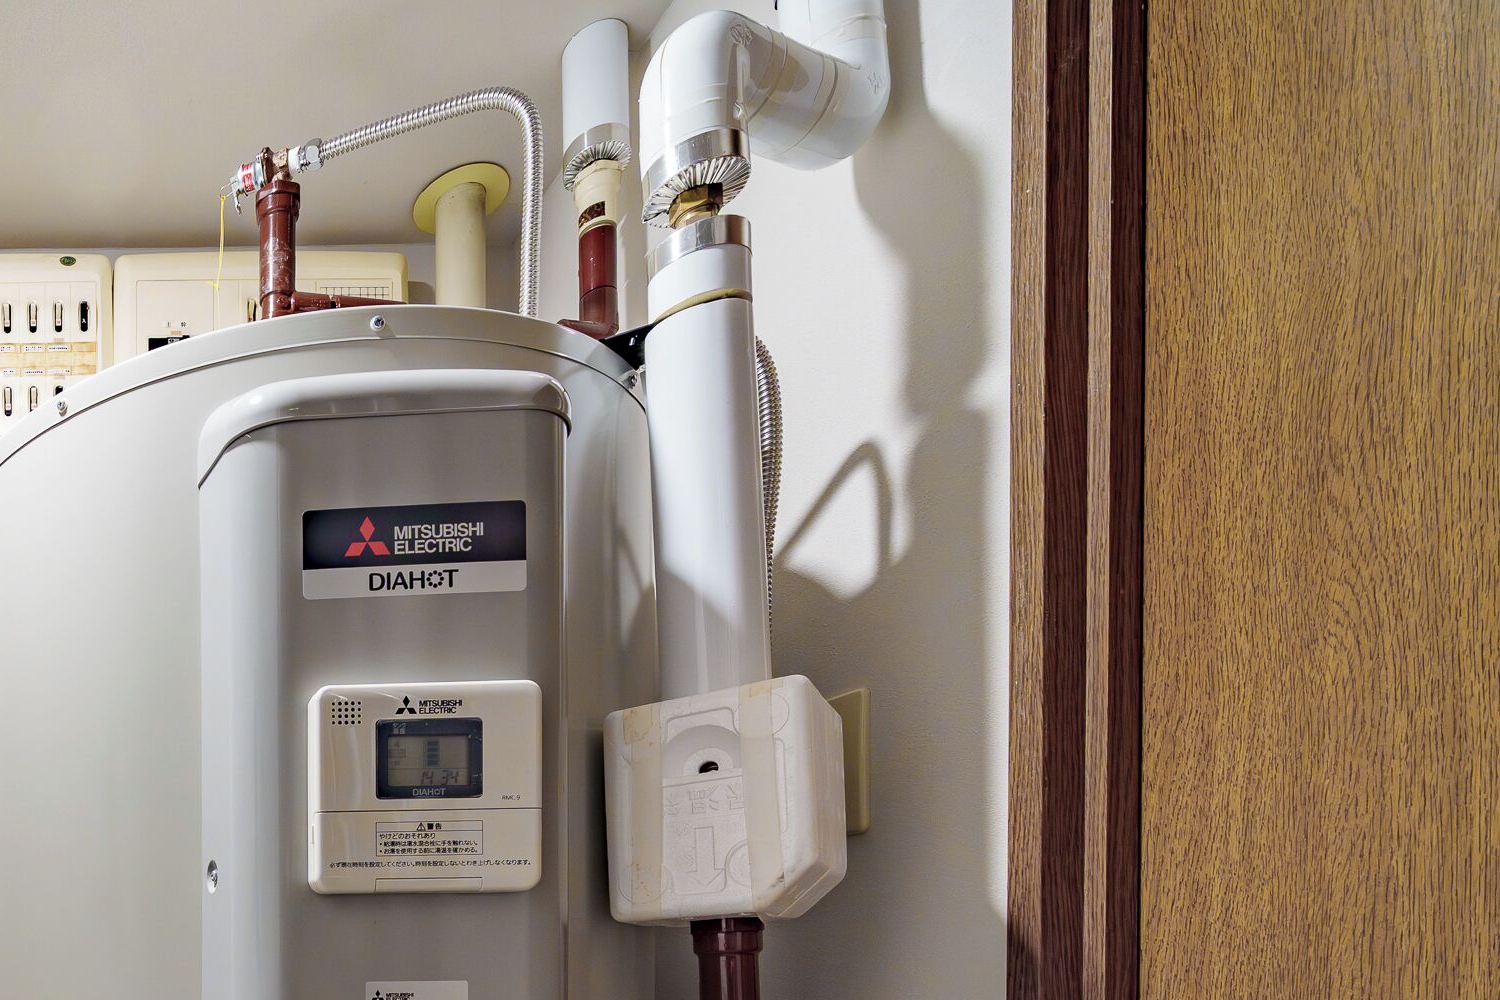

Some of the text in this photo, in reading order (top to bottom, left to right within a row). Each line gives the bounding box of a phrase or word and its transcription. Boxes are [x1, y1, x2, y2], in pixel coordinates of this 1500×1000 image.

[393, 521, 485, 541] MITSUBISHI
[393, 537, 473, 556] ELECTRIC
[368, 568, 460, 592] DIAHOT
[418, 699, 463, 708] MITSUBISHI
[418, 706, 457, 715] ELECTRIC
[412, 787, 447, 797] DIAHOT
[379, 832, 436, 840] やけどのおそれあり
